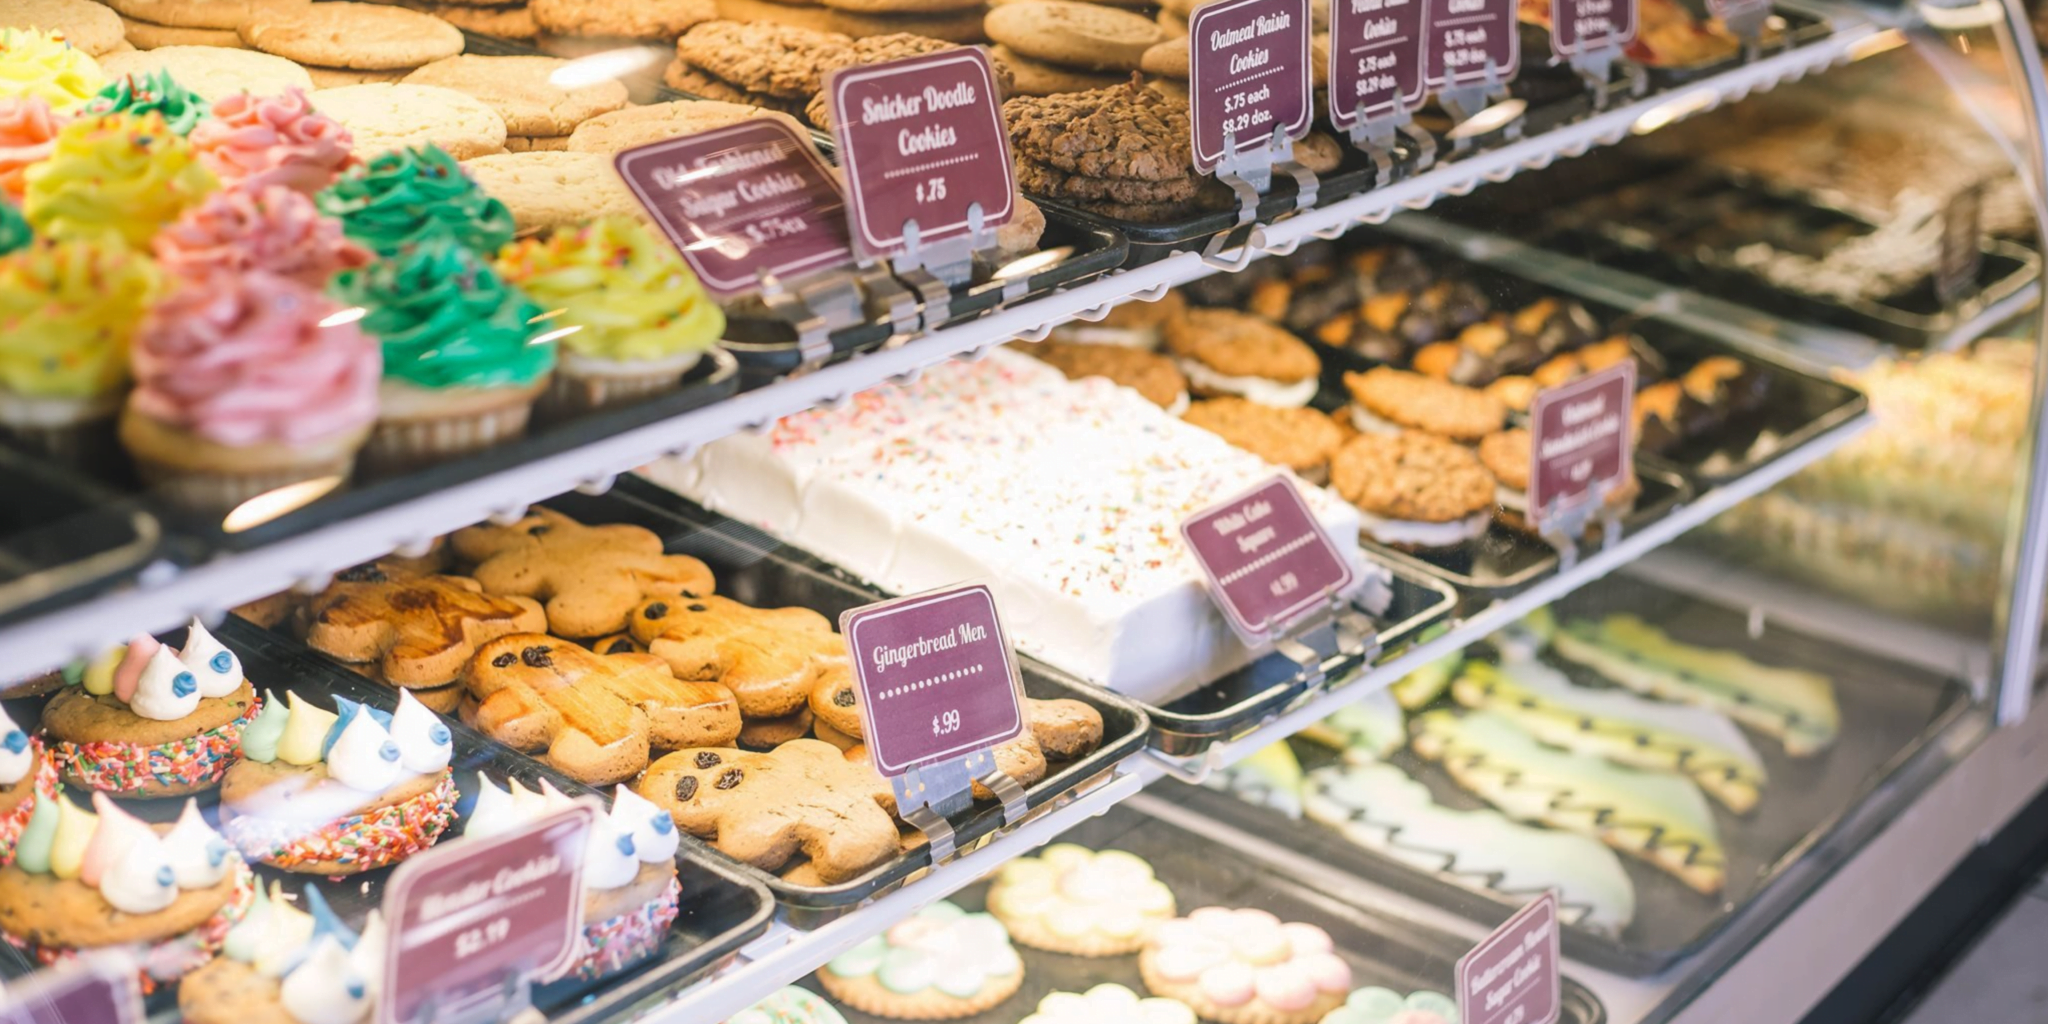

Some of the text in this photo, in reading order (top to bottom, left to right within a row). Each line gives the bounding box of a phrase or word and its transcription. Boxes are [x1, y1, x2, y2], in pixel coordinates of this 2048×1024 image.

[1211, 11, 1290, 51] Oatmeal Raisin
[1363, 16, 1397, 40] Cookies
[1230, 48, 1269, 75] Cookies
[1377, 51, 1397, 70] each
[862, 81, 976, 126] Snicker Doodle
[1224, 84, 1270, 113] $.75 each
[1223, 109, 1273, 136] $8.29 doz.
[898, 123, 957, 155] Cookies
[679, 173, 806, 218] Sugar Cookies
[873, 622, 987, 673] Gingerbread Men
[932, 709, 960, 737] $.99
